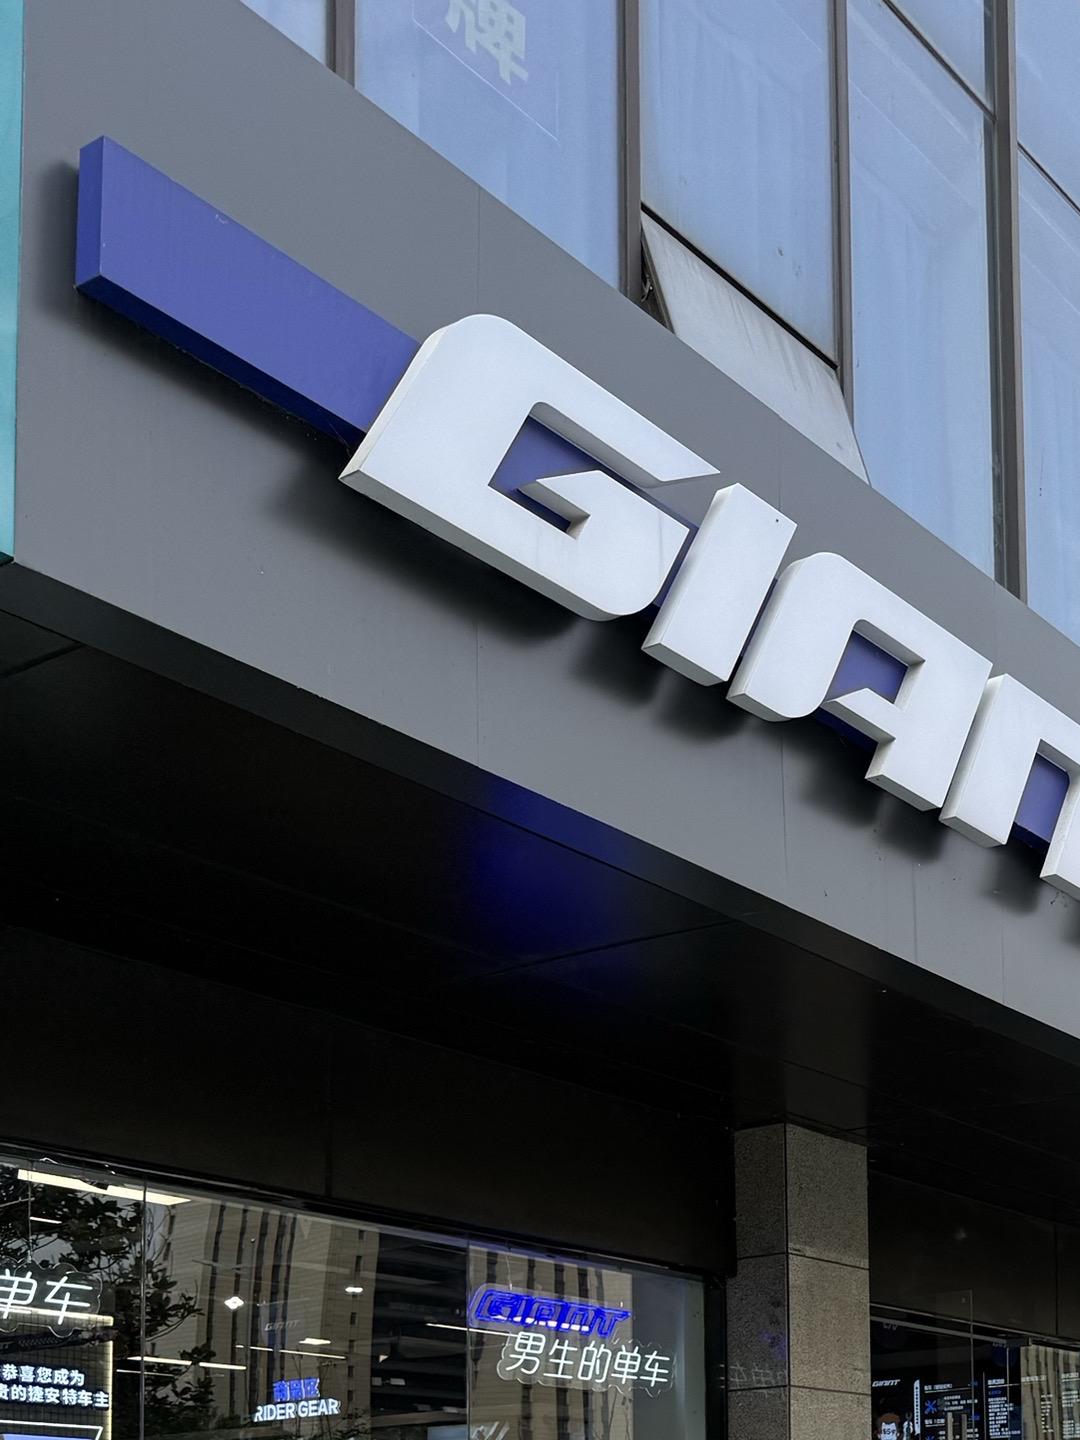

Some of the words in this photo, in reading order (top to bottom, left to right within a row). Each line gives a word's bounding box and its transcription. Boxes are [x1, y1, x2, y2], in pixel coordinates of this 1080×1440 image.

[475, 1288, 632, 1338] GIANT
[2, 1364, 85, 1387] 恭喜您成为
[505, 1331, 671, 1388] 男生的单车
[253, 1402, 297, 1423] RIDER
[297, 1398, 341, 1418] GEAR
